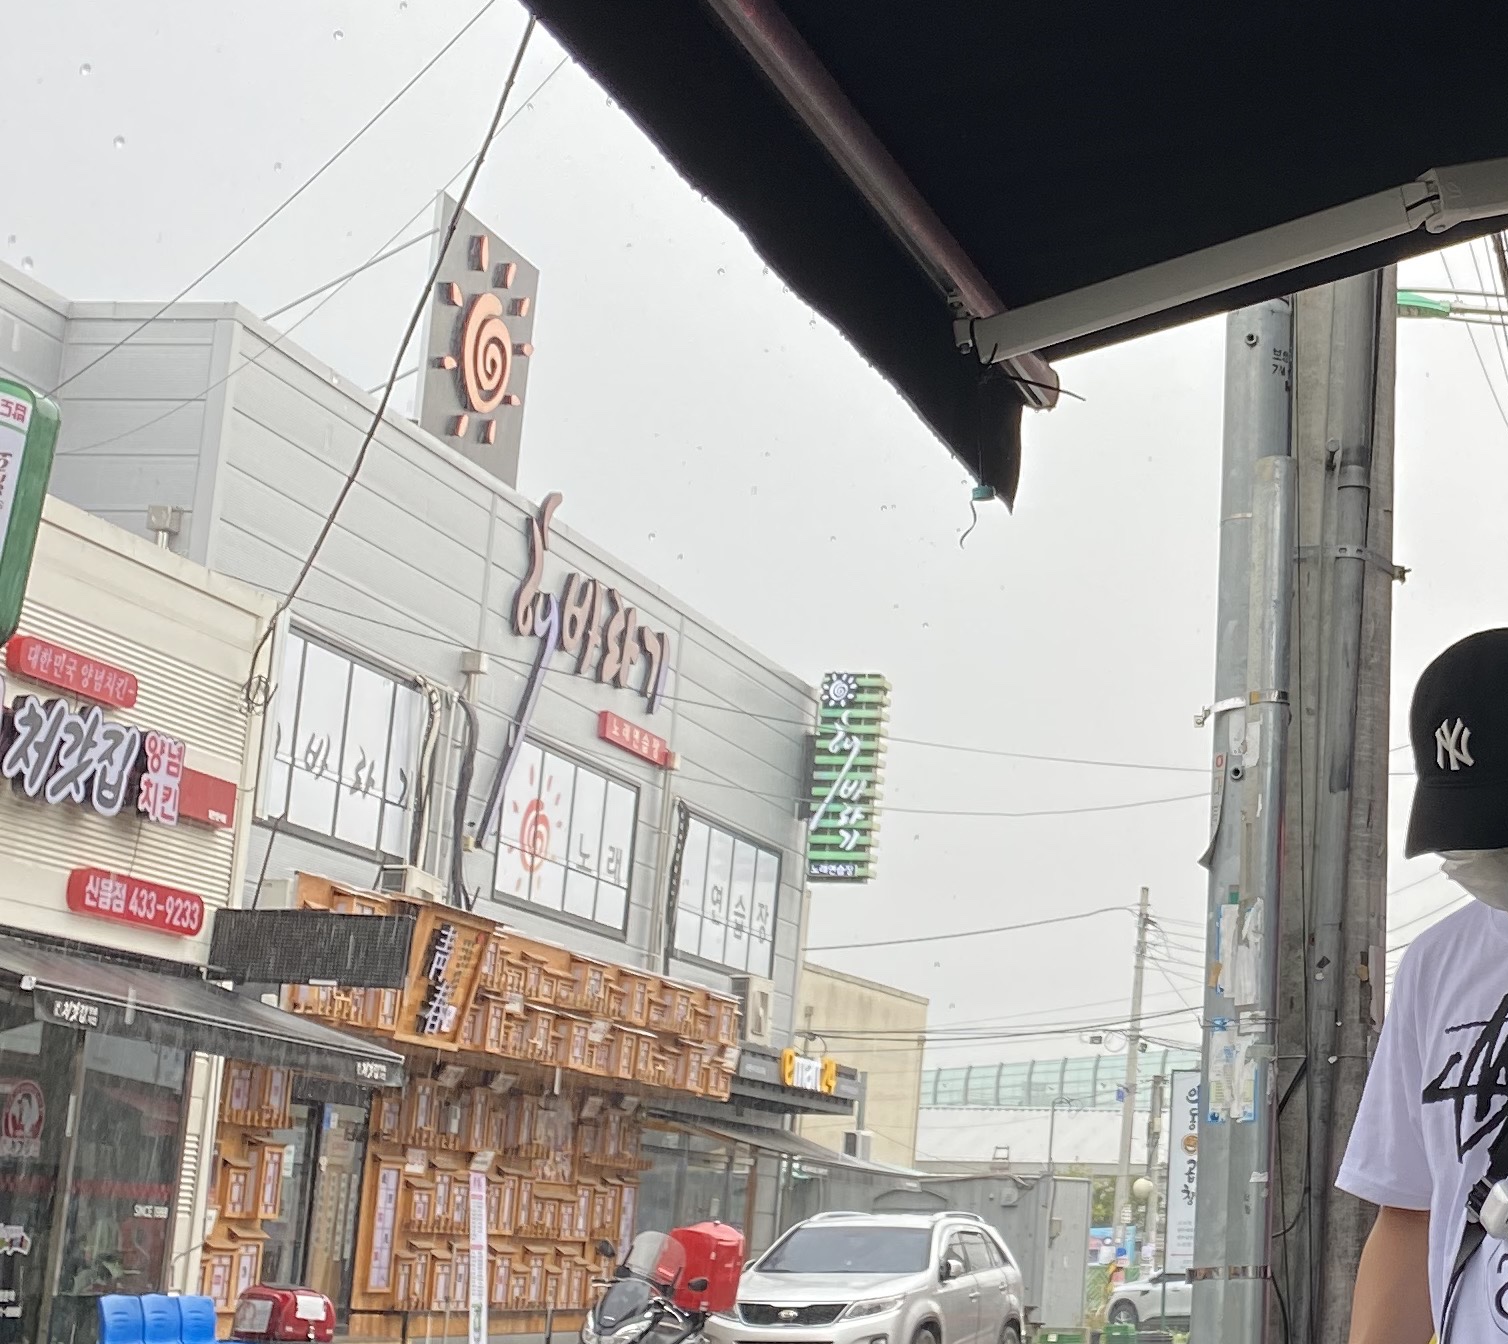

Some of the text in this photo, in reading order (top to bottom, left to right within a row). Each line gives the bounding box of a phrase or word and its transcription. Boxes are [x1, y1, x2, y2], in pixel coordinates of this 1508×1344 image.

[27, 644, 78, 683] 대한민국
[5, 700, 184, 812] 처갓집 양념
[1435, 717, 1475, 771] NY
[141, 779, 178, 822] 치킨
[809, 709, 867, 851] 해바라기
[576, 833, 623, 884] 노래
[128, 889, 201, 931] 433-9233
